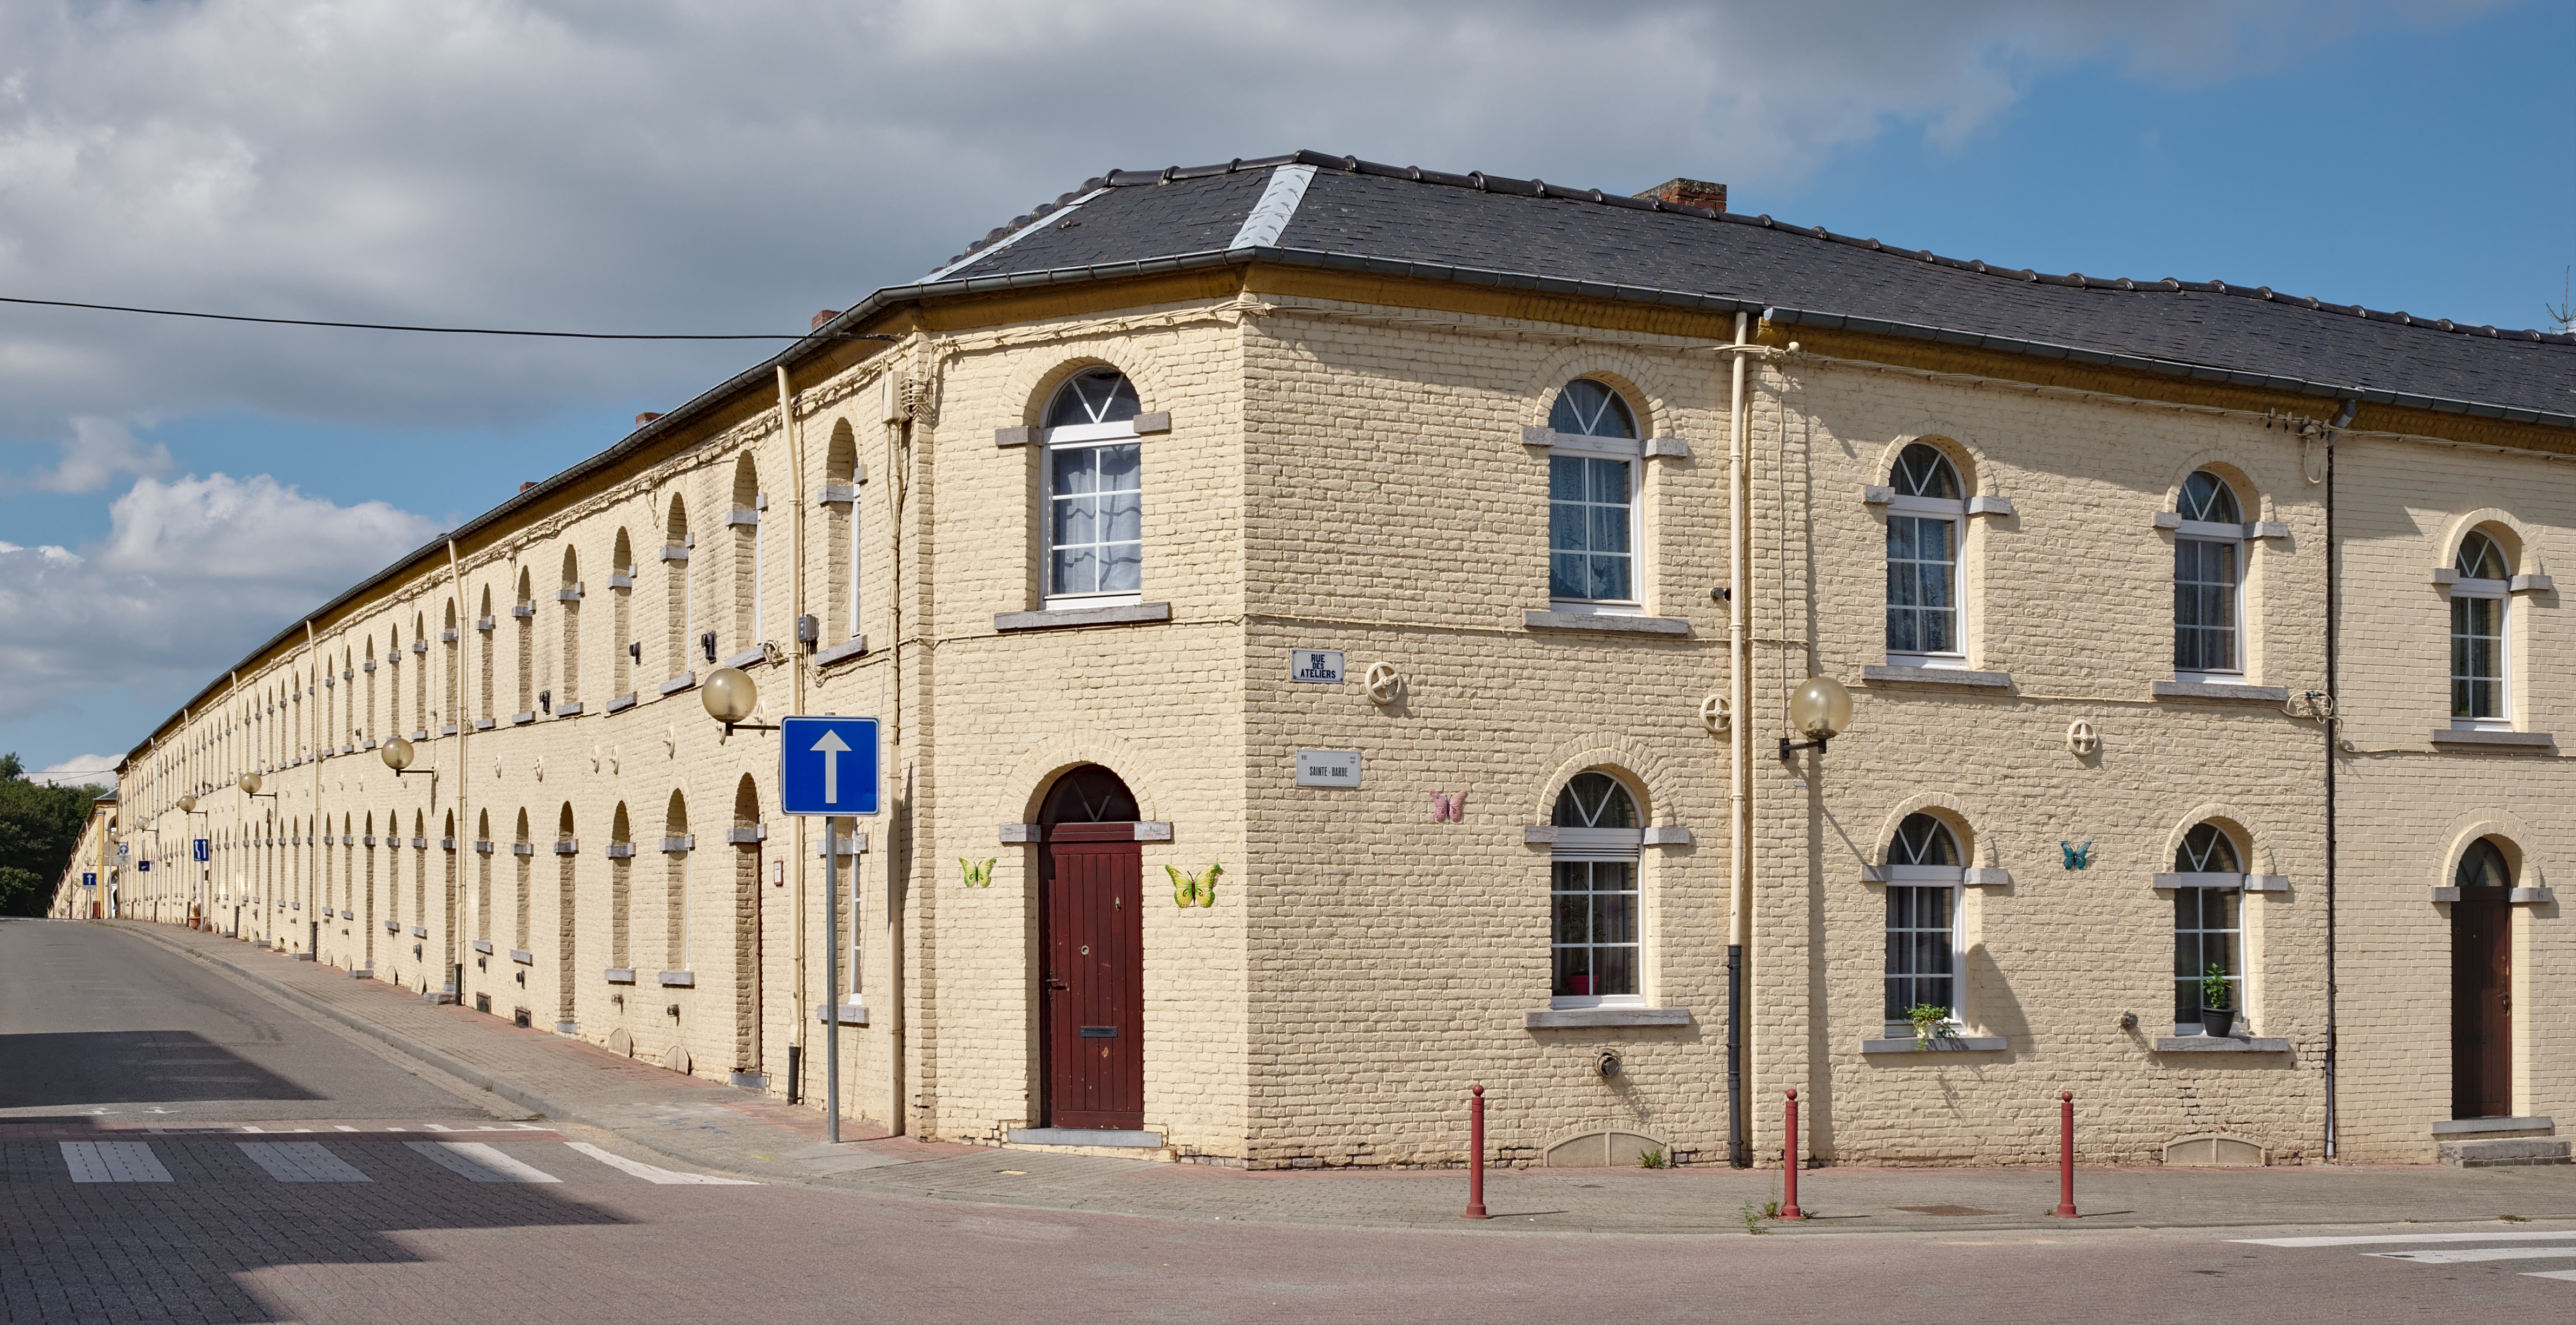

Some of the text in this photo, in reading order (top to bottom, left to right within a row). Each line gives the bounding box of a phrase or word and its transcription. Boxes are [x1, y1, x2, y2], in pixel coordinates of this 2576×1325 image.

[1311, 654, 1325, 663] RUE
[1300, 669, 1336, 678] ATELIERS
[2538, 890, 2543, 900] 6
